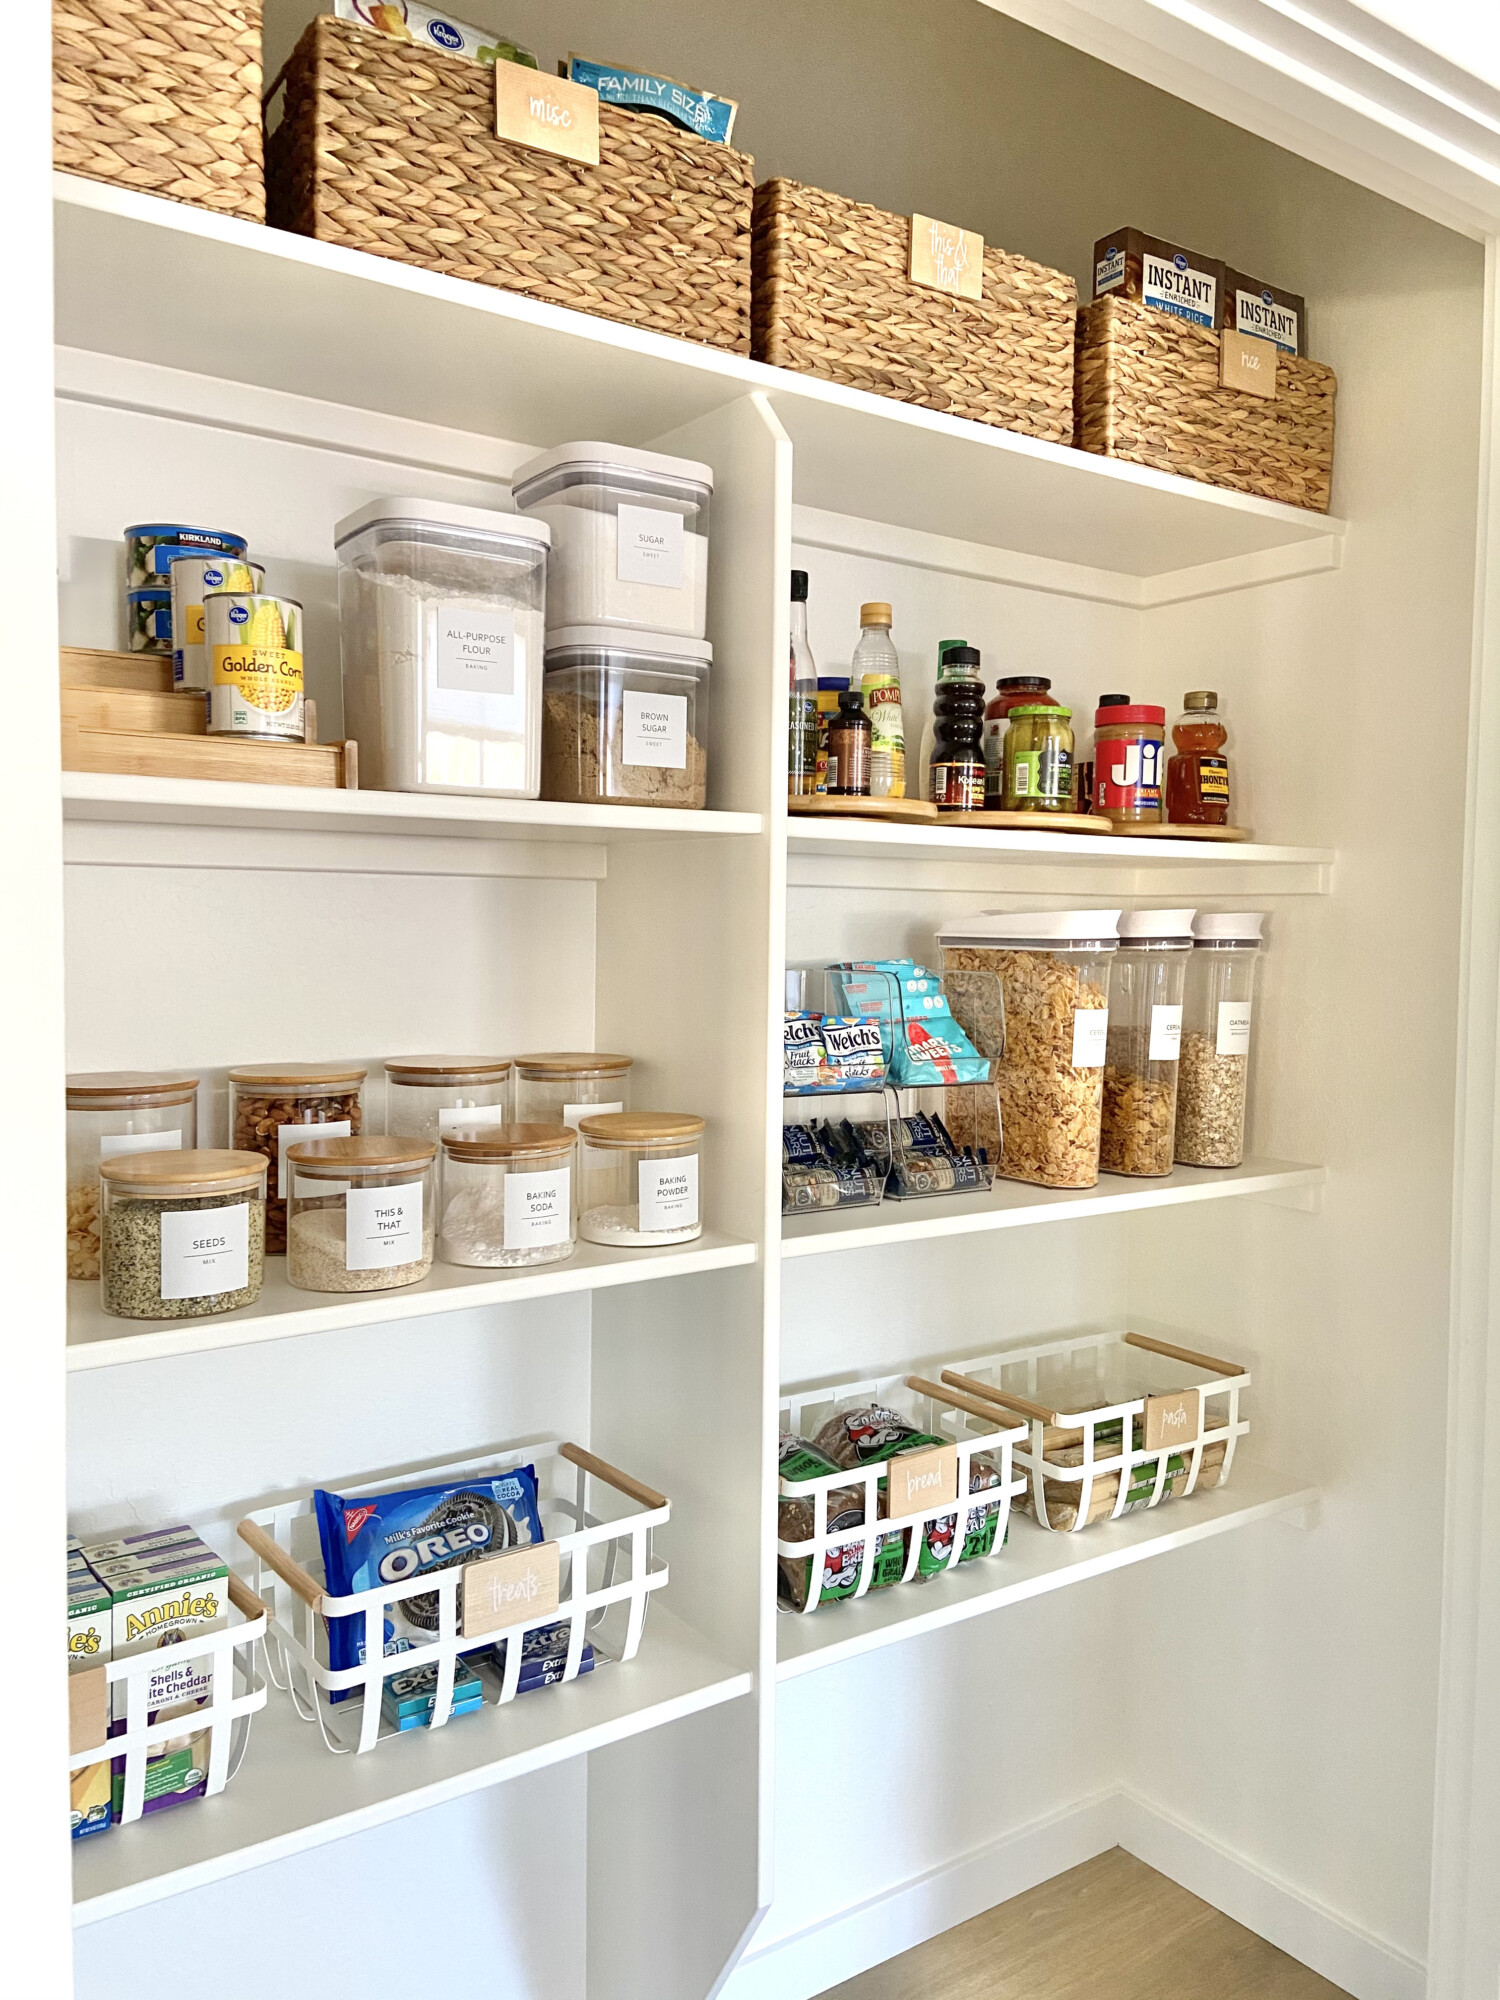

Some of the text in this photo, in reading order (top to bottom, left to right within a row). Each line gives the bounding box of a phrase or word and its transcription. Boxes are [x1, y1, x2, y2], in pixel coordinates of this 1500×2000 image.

[433, 24, 459, 45] Kroger
[598, 77, 707, 121] FAMILY SIZE
[529, 96, 572, 127] misc
[928, 221, 954, 255] this
[934, 252, 963, 291] that
[1097, 257, 1124, 276] INSTANT
[1148, 264, 1212, 303] INSTANT
[1156, 301, 1183, 315] WHITE
[1164, 291, 1196, 308] ENRICHED
[1240, 299, 1294, 336] INSTANT
[1255, 325, 1282, 340] ENRICHED
[1241, 351, 1261, 370] rice
[179, 533, 222, 546] KIRKLAND
[638, 533, 664, 545] SUGAR
[446, 630, 506, 645] ALL-PURPOSE
[252, 650, 286, 660] SWEET
[462, 644, 491, 655] FLOUR
[222, 656, 277, 675] Golden
[465, 663, 488, 671] BAKING
[640, 711, 669, 722] BROWN
[788, 720, 815, 732] EASONED
[642, 723, 667, 733] SUGAR
[784, 1024, 820, 1041] elch's
[827, 1029, 880, 1051] Welch's
[790, 1050, 810, 1060] Fruit
[962, 1156, 976, 1182] NUT
[659, 1175, 686, 1186] BAKING
[850, 1169, 866, 1196] NUT
[526, 1190, 557, 1201] BAKING
[657, 1186, 689, 1197] POWDER
[374, 1207, 404, 1218] THIS &
[530, 1203, 553, 1212] SODA
[377, 1220, 401, 1231] THAT
[192, 1236, 226, 1250] SEEDS
[1160, 1402, 1187, 1439] pasta
[907, 1458, 943, 1500] bread
[496, 1490, 521, 1499] COCOA
[383, 1511, 475, 1546] Milk's Favorite Cookie
[380, 1523, 489, 1582] OREO
[969, 1530, 989, 1556] 21
[126, 1582, 176, 1598] CERTIFIED
[178, 1571, 217, 1586] ORGANIC
[488, 1566, 541, 1612] treats
[68, 1604, 98, 1617] GANIC
[126, 1591, 219, 1642] Annie's
[145, 1618, 198, 1637] HOMEGROWN
[522, 1627, 570, 1656] xtra
[150, 1666, 194, 1687] Shells &
[147, 1695, 173, 1707] CARONI
[181, 1685, 208, 1697] CHEESE
[148, 1674, 213, 1700] ite Cheddar
